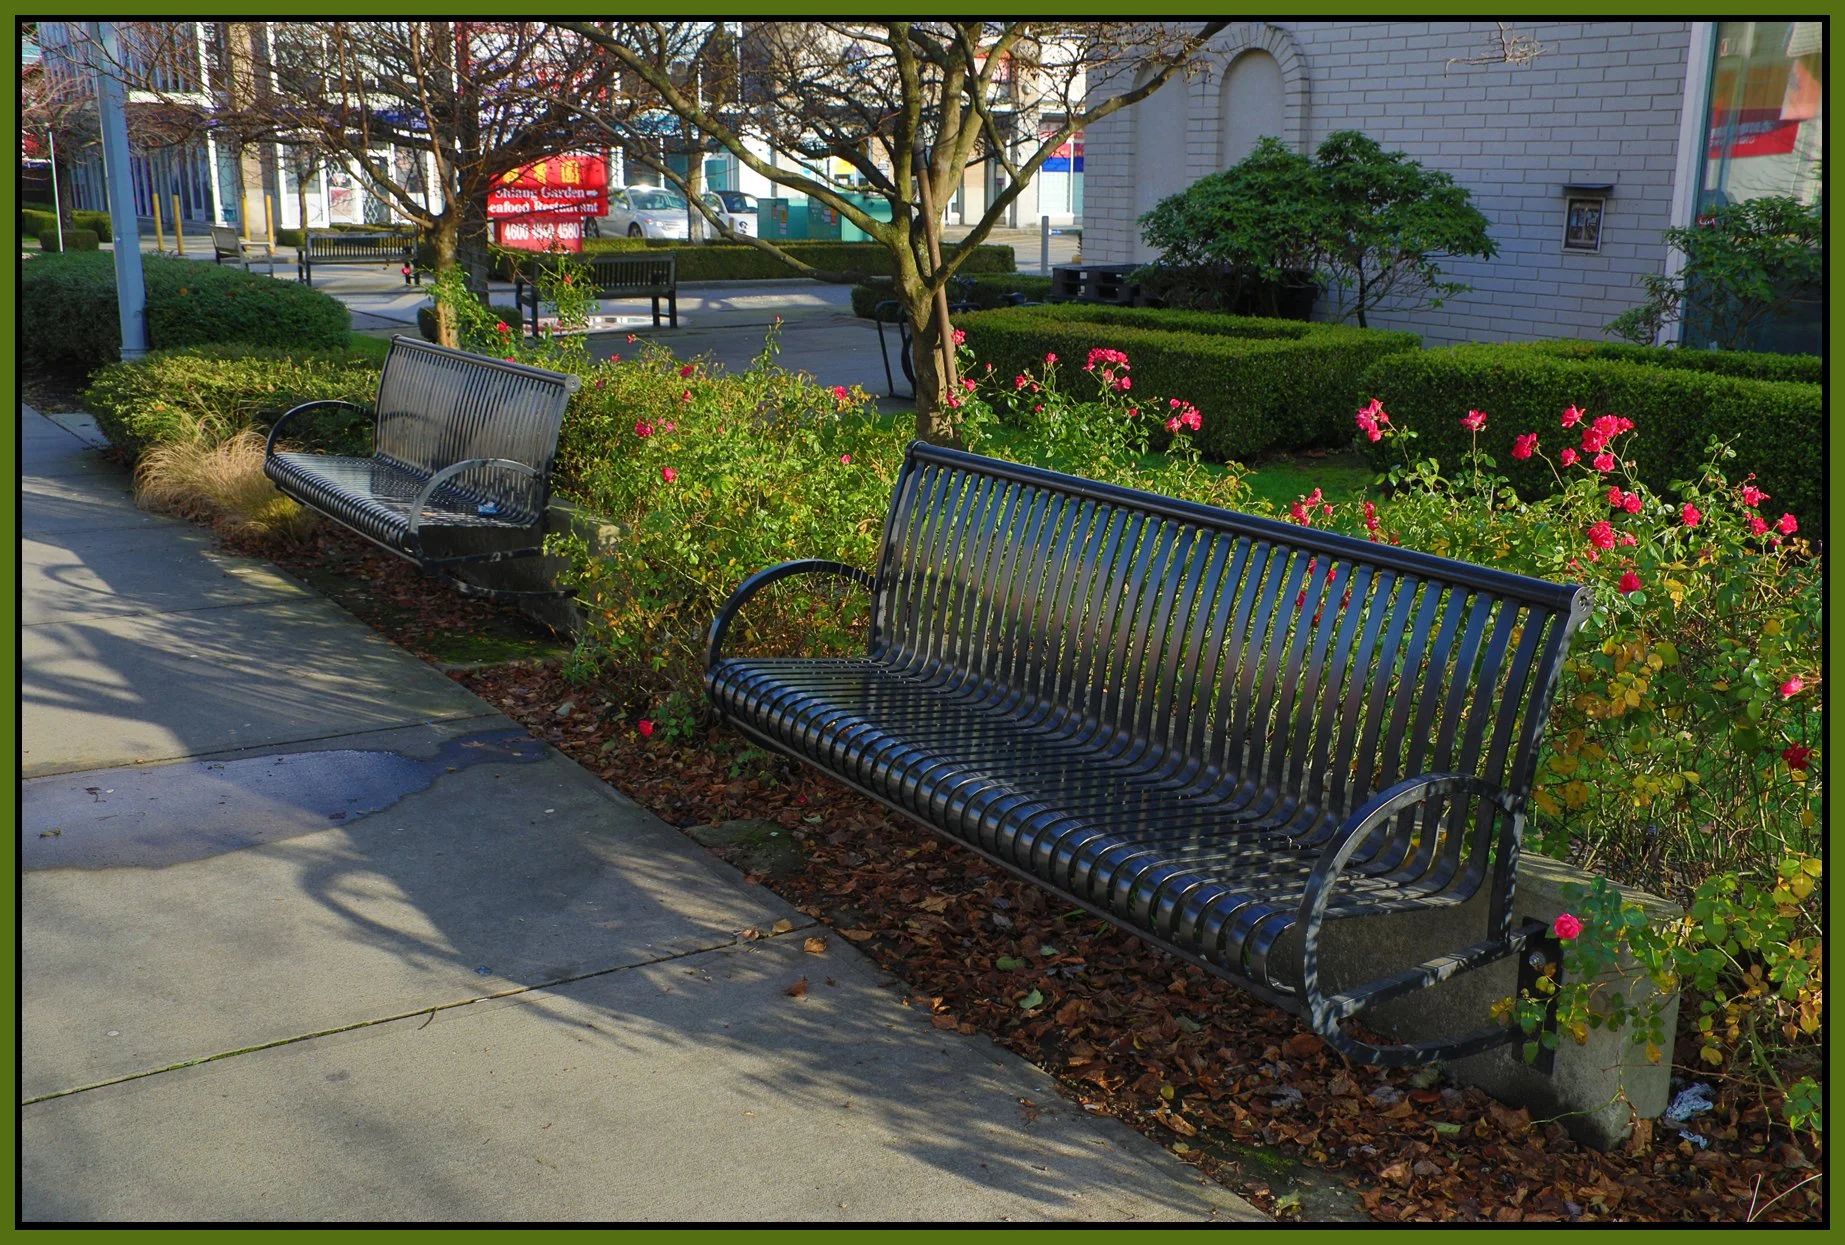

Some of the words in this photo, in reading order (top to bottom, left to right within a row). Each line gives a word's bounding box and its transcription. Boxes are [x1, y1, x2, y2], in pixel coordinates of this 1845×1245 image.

[541, 186, 585, 199] Garden
[488, 201, 530, 213] eafood
[557, 222, 580, 239] 4580
